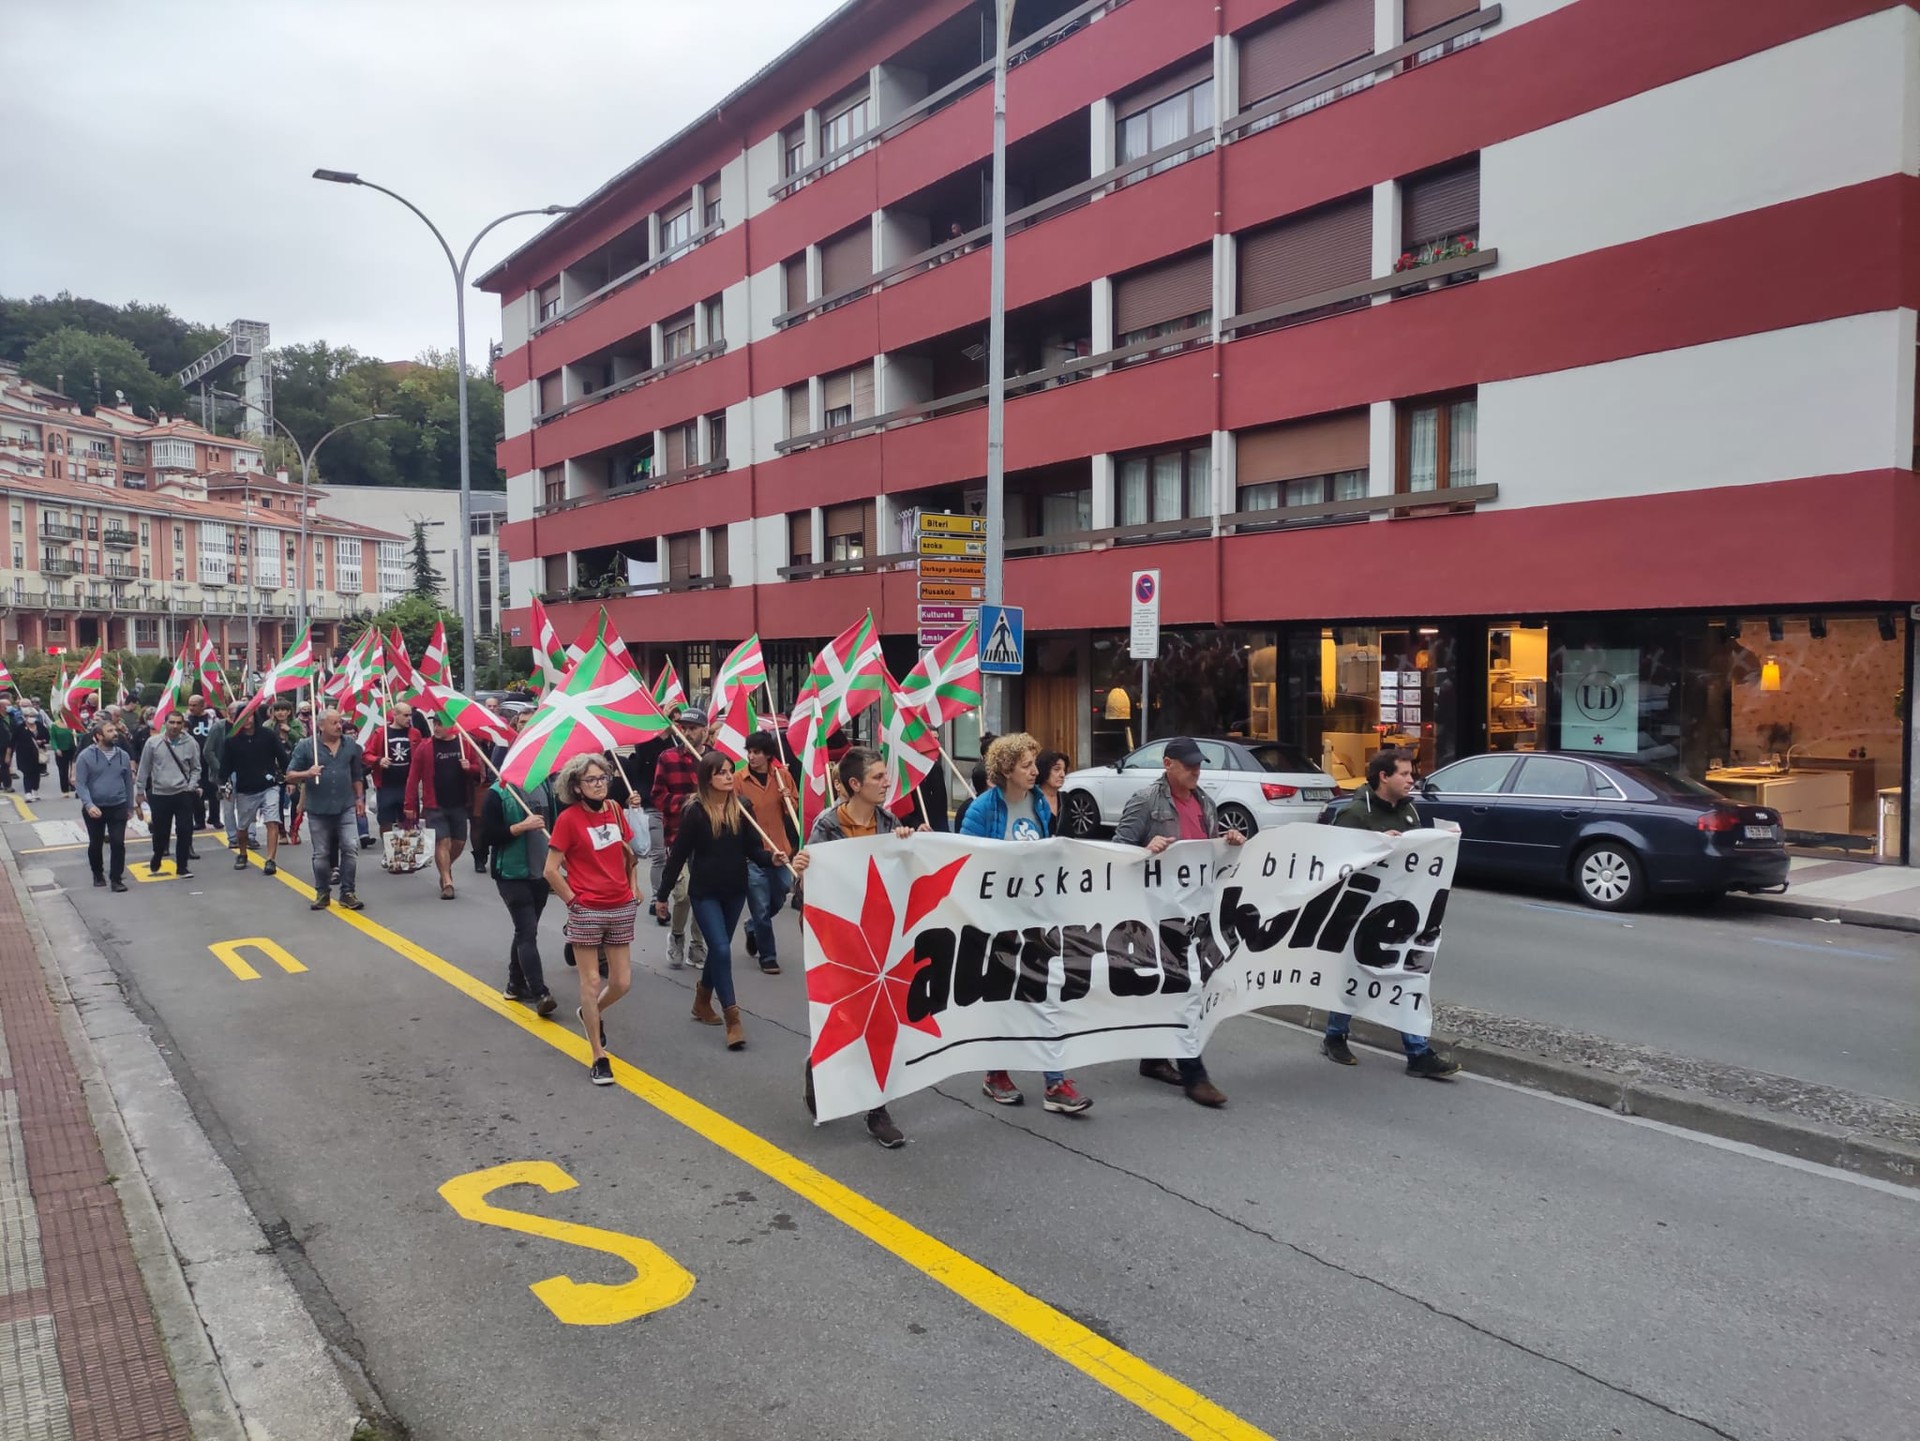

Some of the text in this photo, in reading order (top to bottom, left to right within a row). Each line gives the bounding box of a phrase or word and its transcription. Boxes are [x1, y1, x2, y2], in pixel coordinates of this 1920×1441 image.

[926, 519, 949, 528] Biteri
[922, 588, 955, 596] Musakola
[1582, 685, 1618, 710] UD
[978, 862, 1112, 900] Euskal
[1261, 851, 1445, 882] bihoea
[1344, 977, 1423, 1011] 2021
